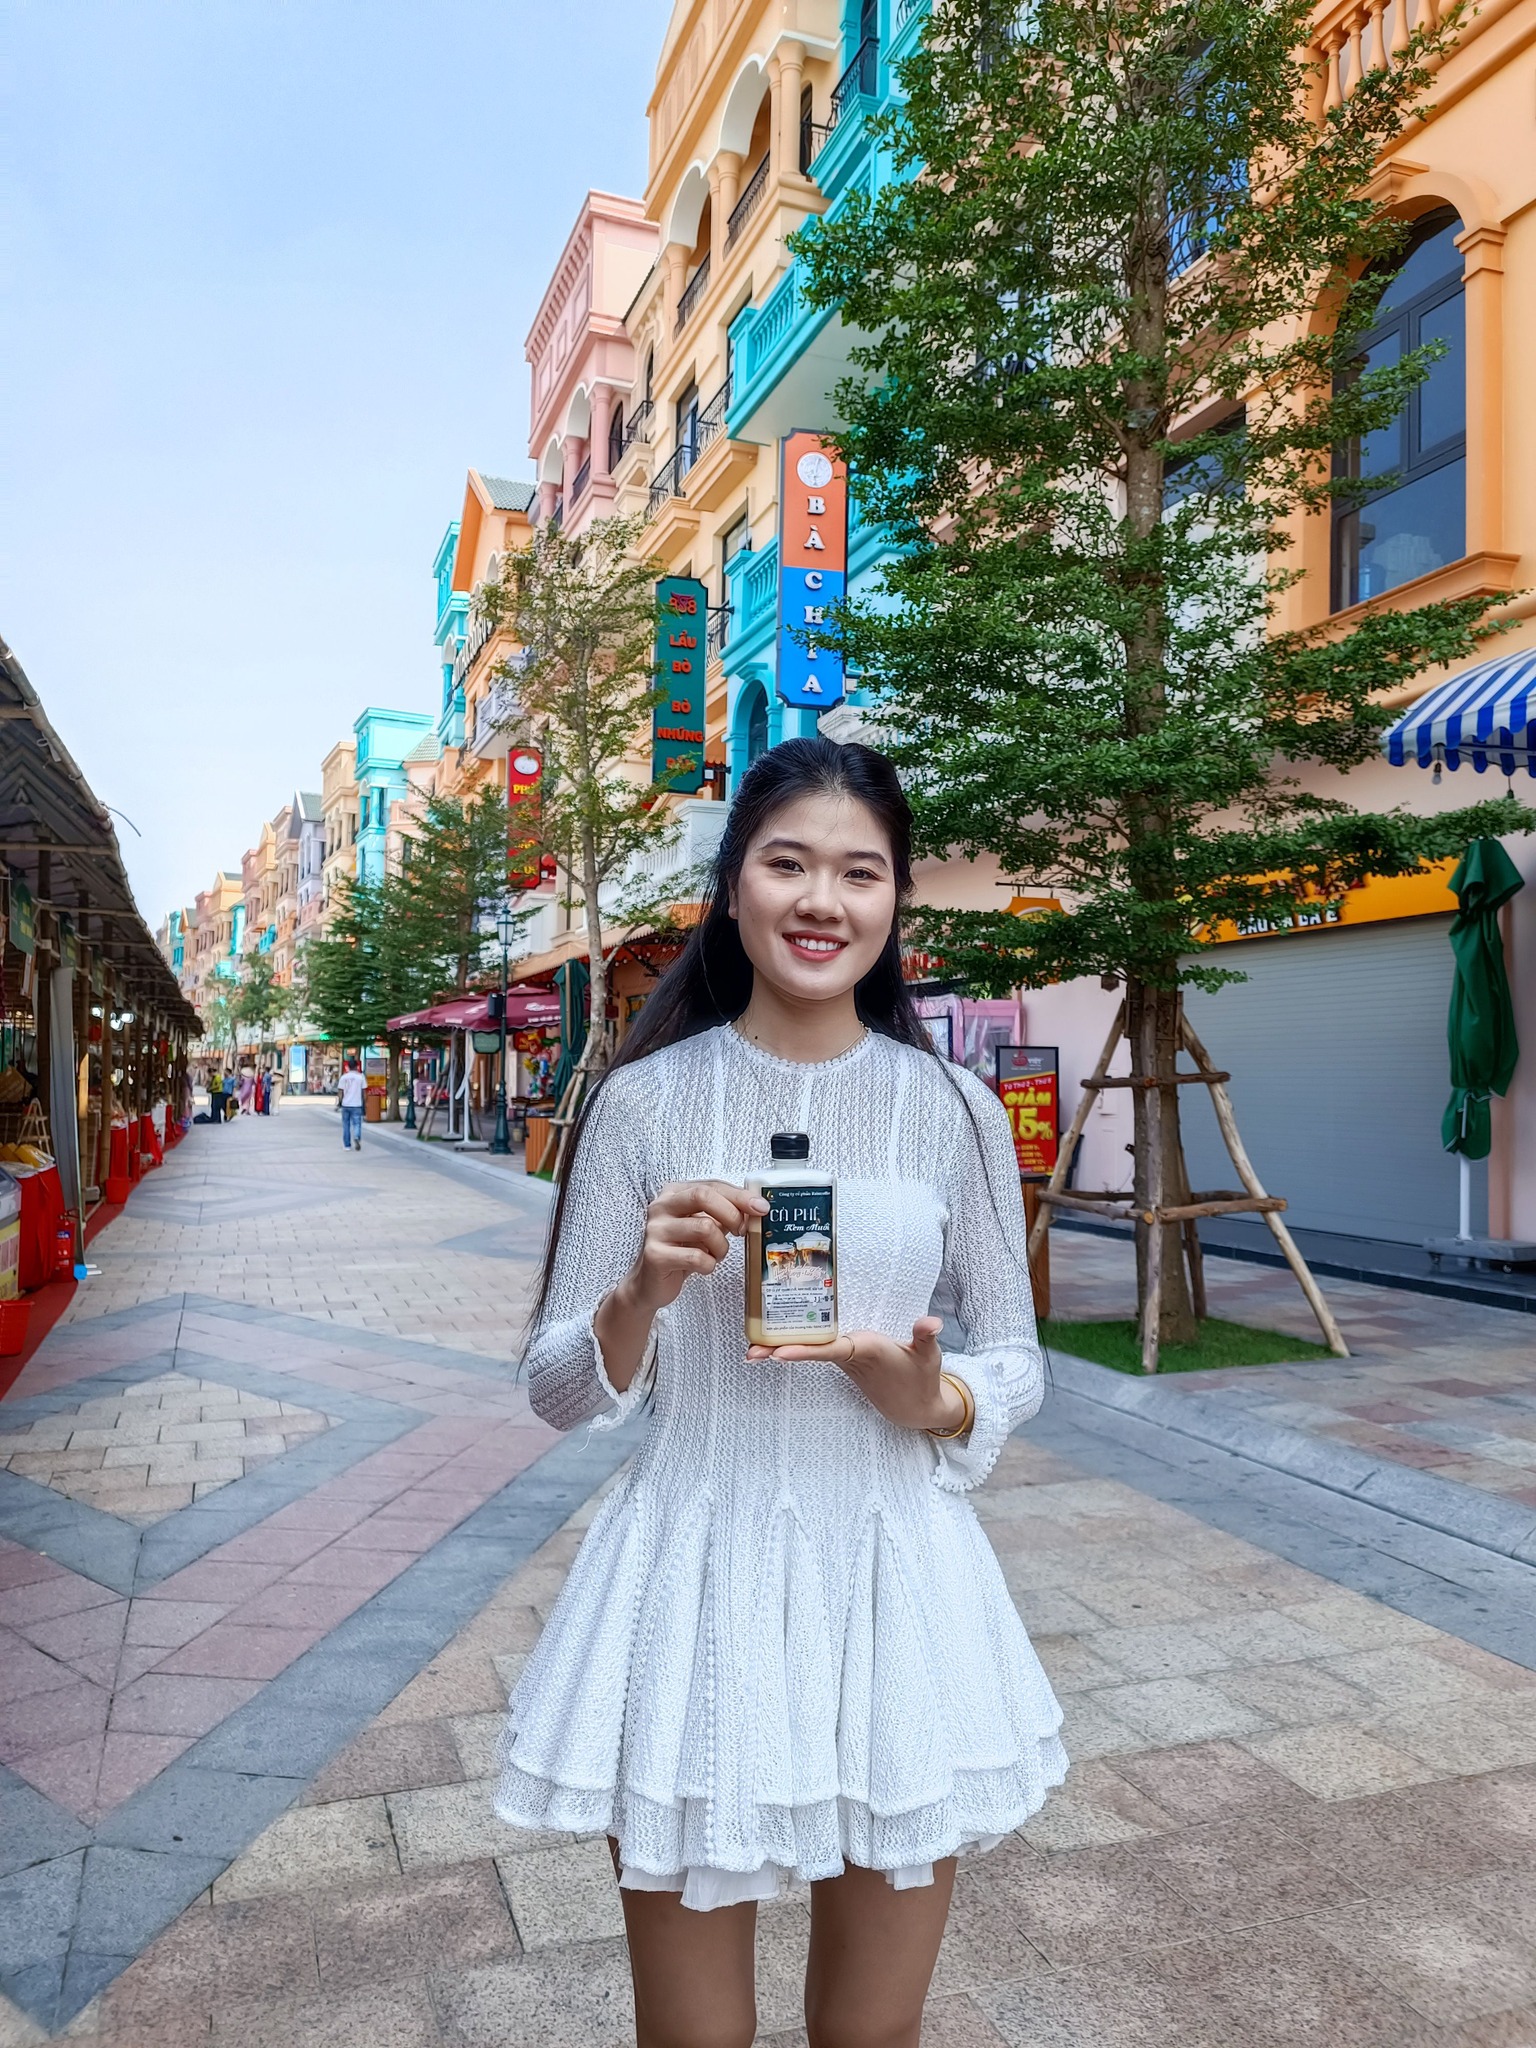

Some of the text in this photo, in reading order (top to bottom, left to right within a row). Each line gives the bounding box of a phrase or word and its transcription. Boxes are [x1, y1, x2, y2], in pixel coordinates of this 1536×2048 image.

[803, 495, 826, 550] BÀ
[672, 658, 692, 673] BÒ
[671, 698, 691, 714] BÒ
[657, 727, 704, 742] NHÚNG
[1003, 1087, 1052, 1107] GIẢM
[1007, 1107, 1054, 1141] 15%
[770, 1205, 820, 1222] CÀ PHÊ
[783, 1222, 831, 1232] Kem Muối
